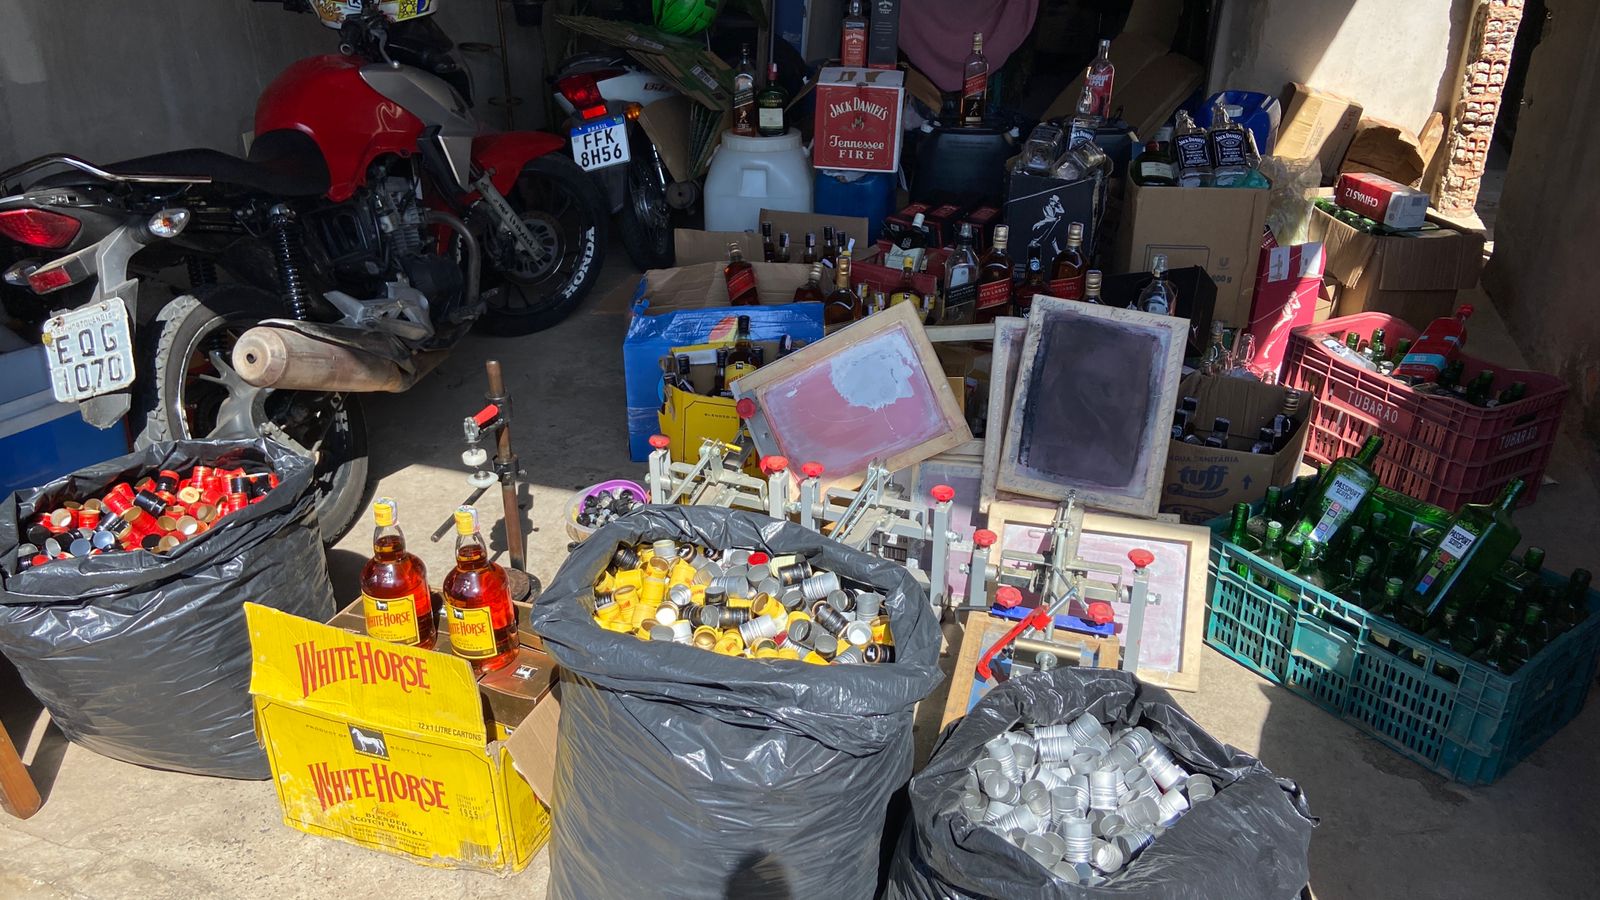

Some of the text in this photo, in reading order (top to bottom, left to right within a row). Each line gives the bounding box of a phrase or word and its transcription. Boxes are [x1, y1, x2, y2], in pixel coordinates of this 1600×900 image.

[830, 96, 889, 121] JACK DANIEL'S
[587, 123, 608, 133] BRASIL
[583, 128, 615, 150] FFK
[829, 134, 885, 150] Tennessee
[581, 143, 622, 168] 8H56
[839, 149, 875, 160] FIRE
[1345, 187, 1379, 208] CHIVAS 12
[561, 226, 595, 300] HONDA
[991, 286, 1009, 295] LABEL
[55, 322, 118, 365] EQG
[63, 355, 124, 394] 1070
[1348, 389, 1399, 425] TUBARÃO
[1501, 426, 1538, 450] TUBARÃO
[1177, 464, 1229, 491] tuff
[1334, 480, 1361, 499] PASSPORT
[1335, 488, 1353, 501] SCOTCH
[1448, 537, 1463, 549] SCOTCH
[1449, 529, 1472, 546] PASSPORT
[383, 611, 411, 627] HORSE
[460, 621, 487, 636] HORSE
[294, 640, 431, 700] WHITE HORSE
[305, 724, 337, 737] PRODUCT
[435, 724, 451, 736] LITRE
[453, 729, 482, 742] CARTONS
[307, 762, 449, 813] WHITE HORSE
[350, 815, 425, 837] SCOTCH WHISKY
[365, 812, 408, 827] BLENDED
